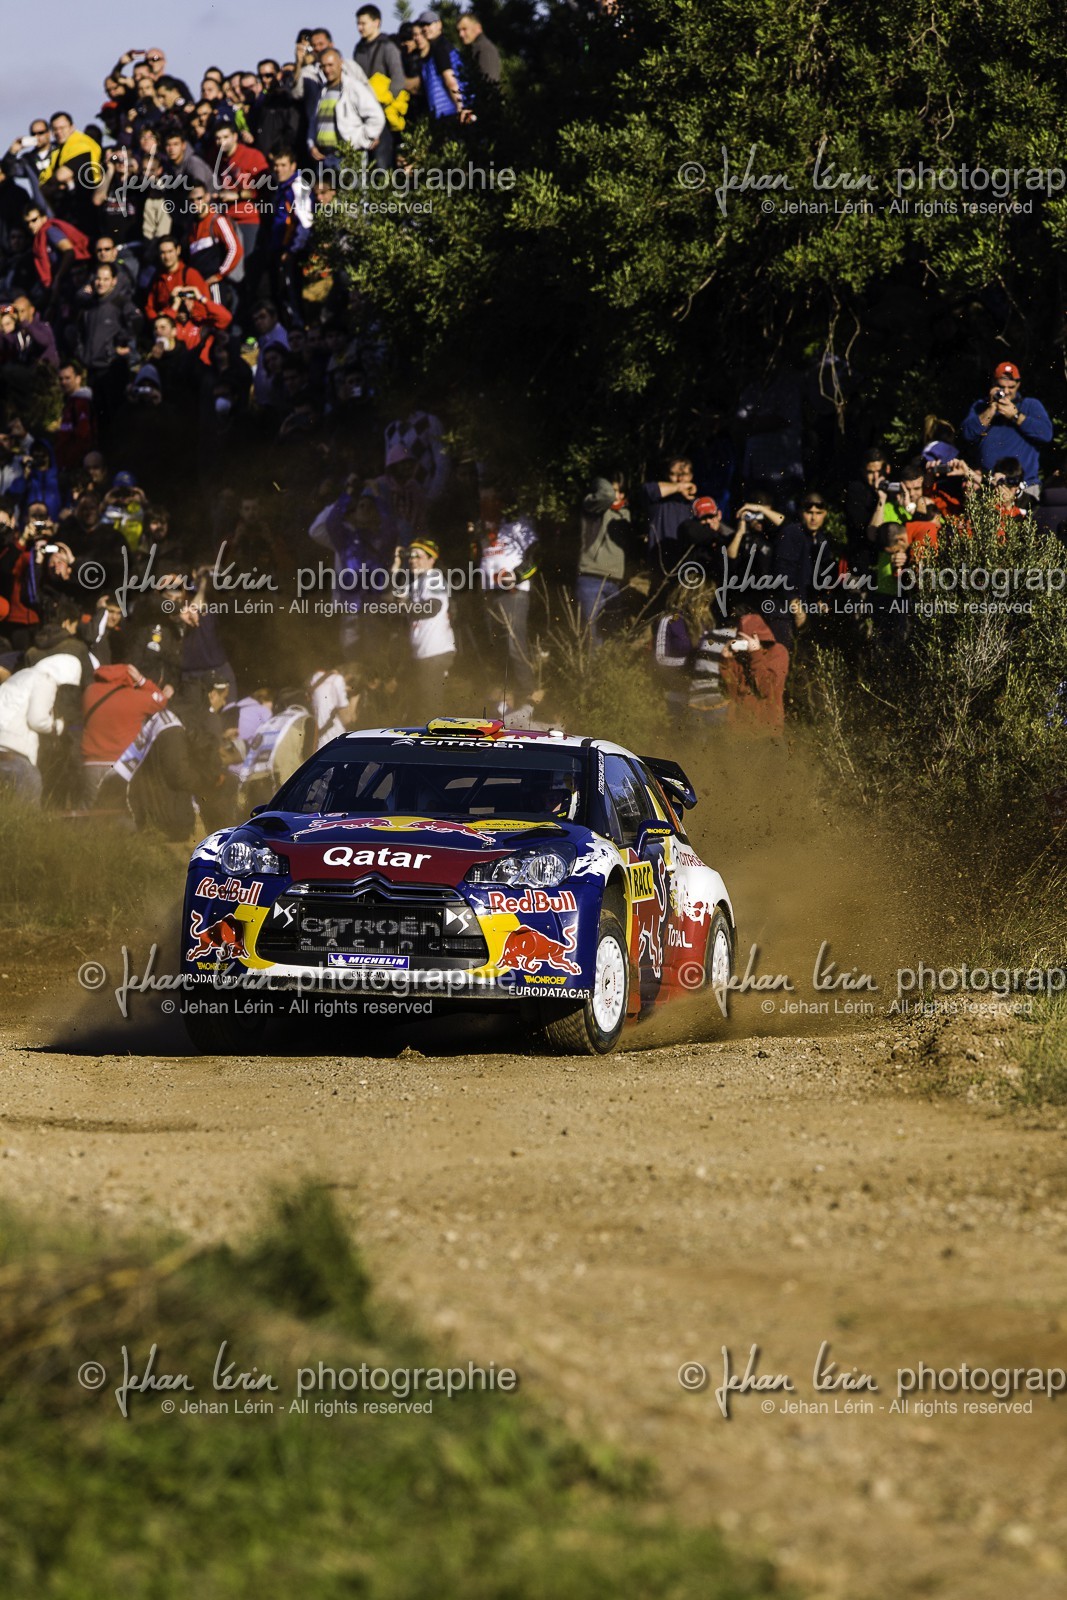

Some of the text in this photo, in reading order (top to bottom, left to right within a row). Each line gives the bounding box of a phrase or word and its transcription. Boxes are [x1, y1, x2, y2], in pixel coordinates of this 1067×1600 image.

[322, 846, 432, 869] Qatar
[632, 865, 653, 898] RACC
[667, 923, 693, 948] TOTAL
[348, 956, 406, 966] MICHELIN
[524, 975, 567, 985] MONROE
[508, 986, 590, 999] EURODATACAR
